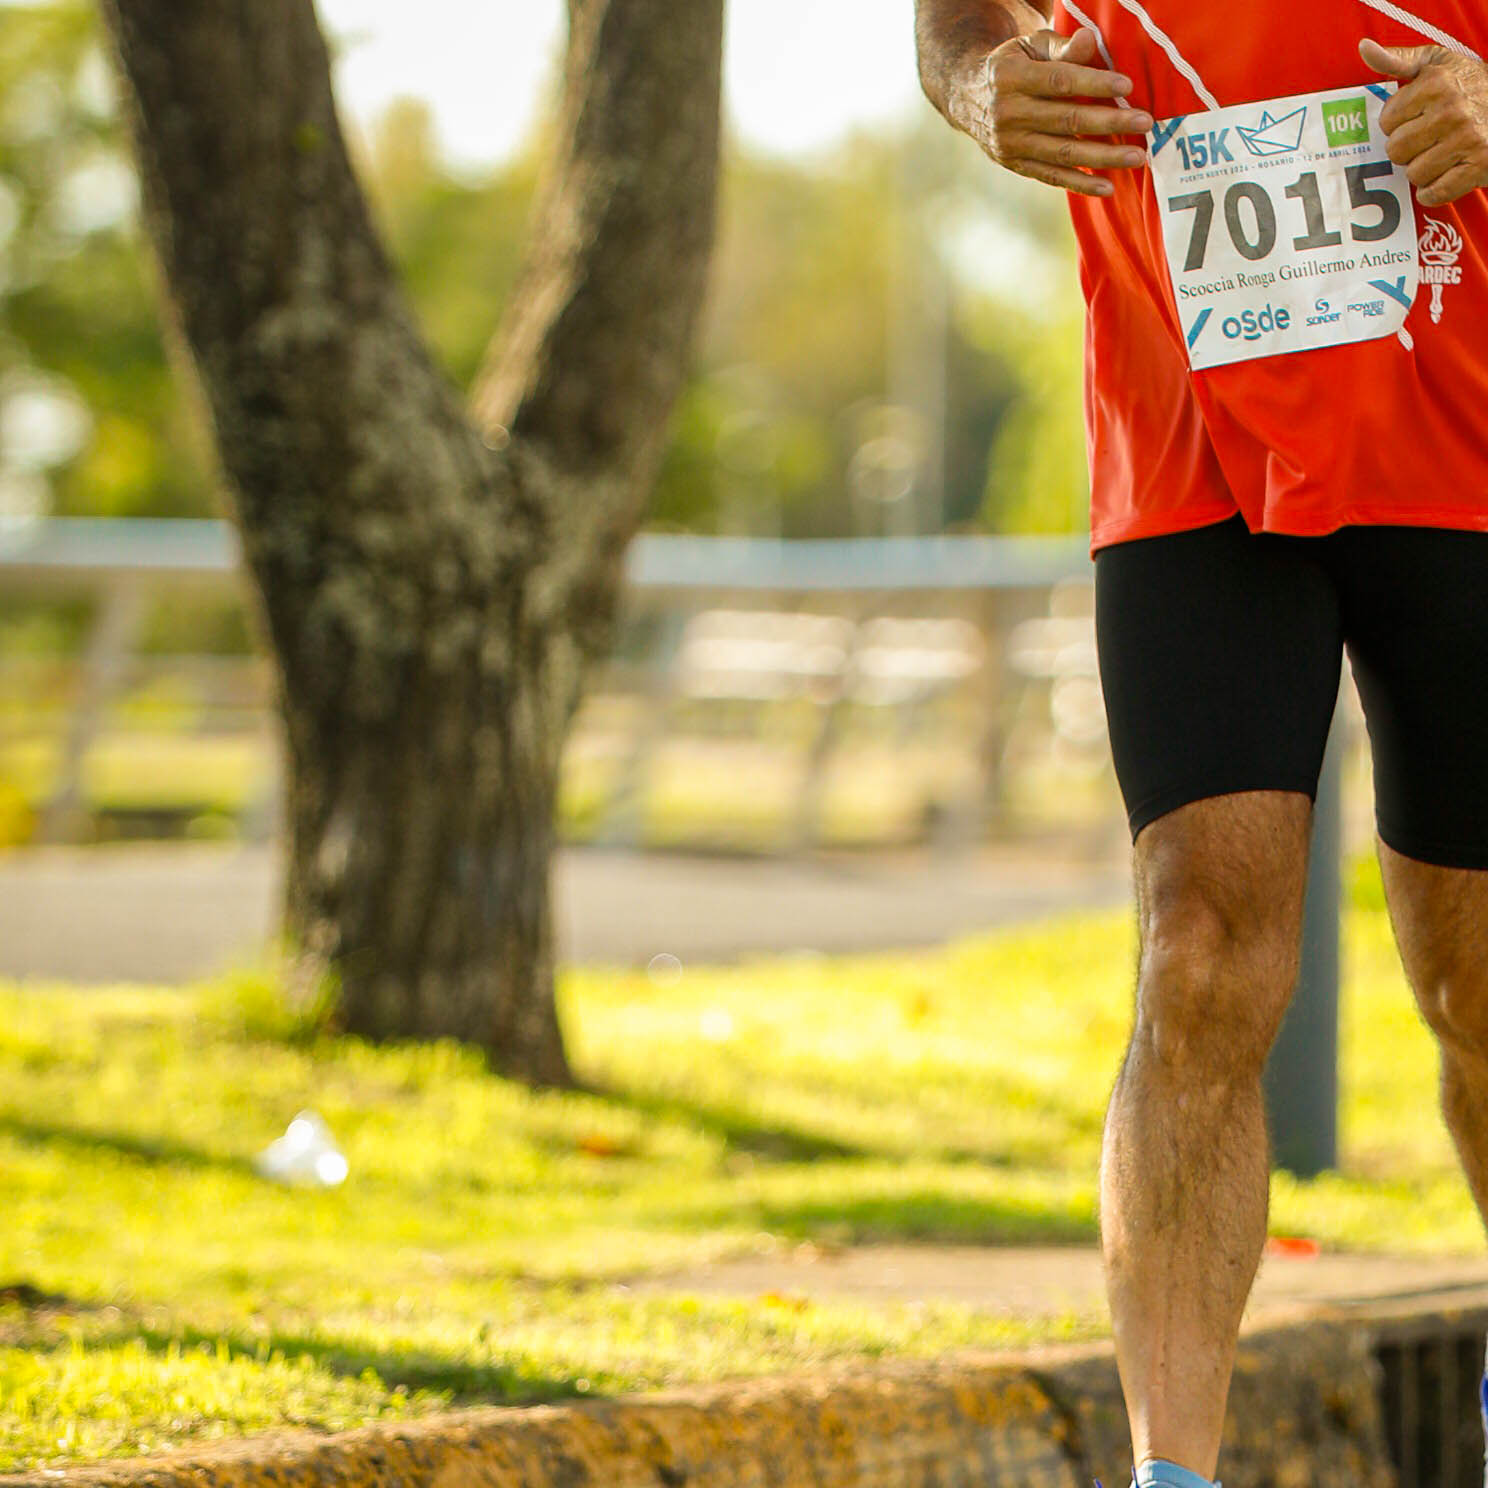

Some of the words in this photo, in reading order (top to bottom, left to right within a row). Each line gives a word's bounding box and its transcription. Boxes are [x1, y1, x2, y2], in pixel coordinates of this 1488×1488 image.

[1326, 110, 1365, 134] 10K
[1175, 127, 1235, 171] 15K
[1257, 155, 1295, 169] ROSARIO
[1314, 151, 1326, 161] DE
[1328, 147, 1352, 158] ABRIL
[1168, 159, 1401, 273] 7015
[1178, 278, 1235, 300] Scoccia
[1236, 269, 1277, 289] Ronga
[1279, 260, 1356, 282] Guillermo
[1359, 247, 1412, 270] Andres
[1221, 303, 1291, 340] osde
